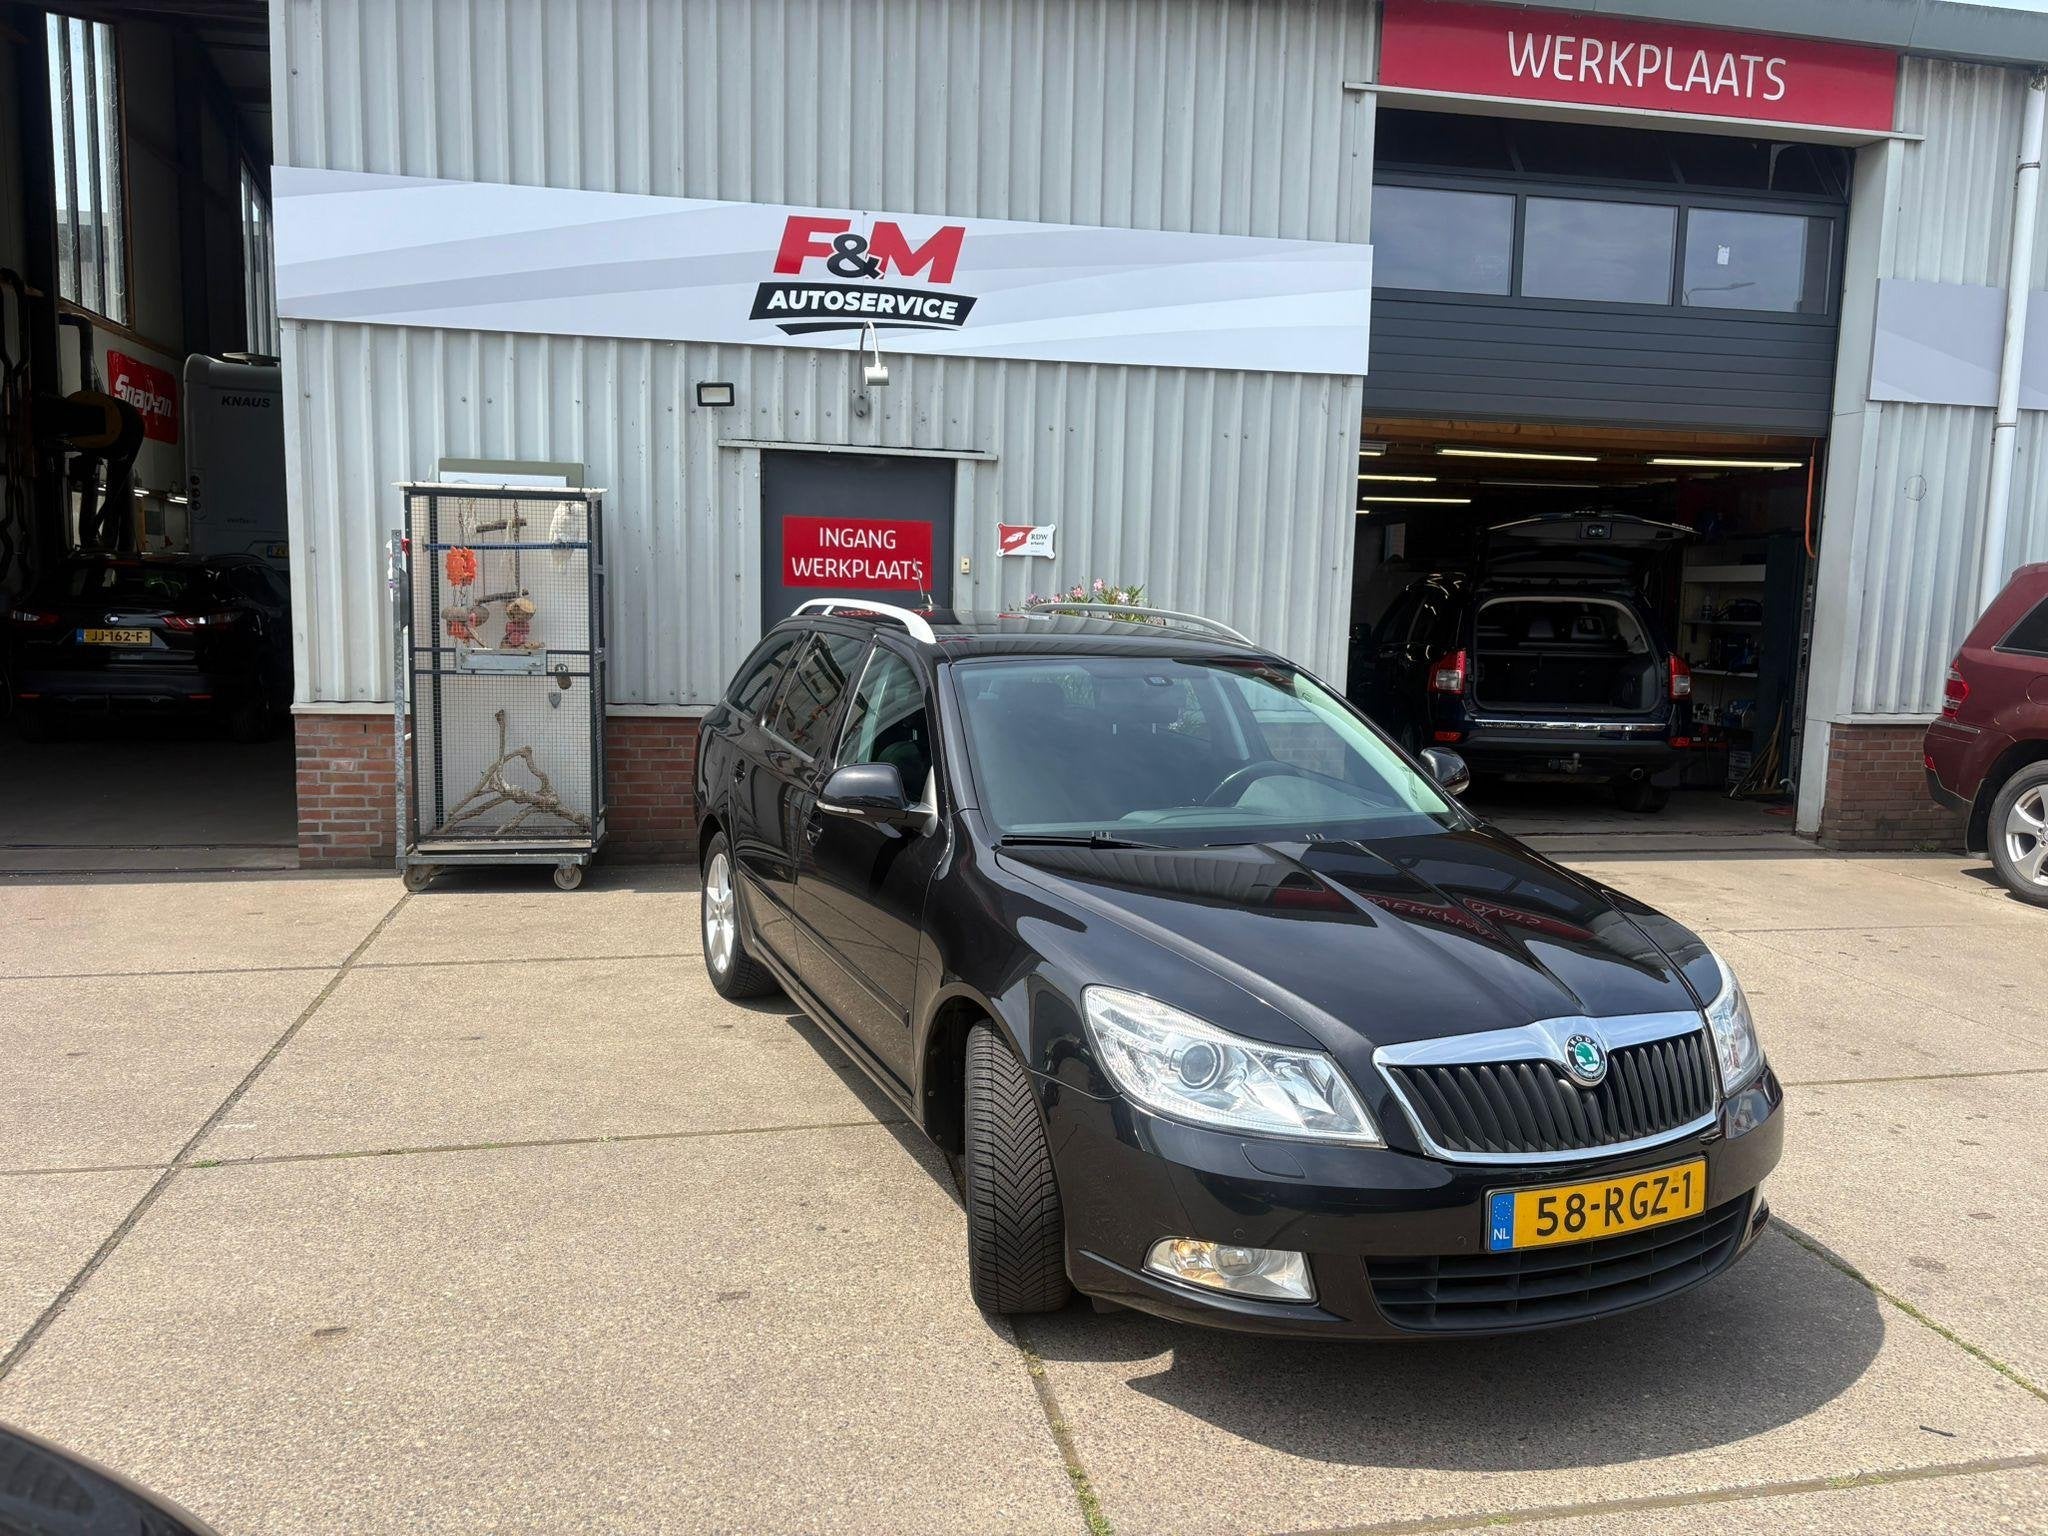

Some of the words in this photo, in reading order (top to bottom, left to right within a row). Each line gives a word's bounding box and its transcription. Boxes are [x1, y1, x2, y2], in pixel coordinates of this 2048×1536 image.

[1507, 30, 1787, 101] WERKPLAATS
[772, 214, 966, 284] F&M
[766, 289, 959, 320] AUTOSERVICE
[113, 373, 172, 416] Snap-on
[221, 395, 271, 408] KNAUS
[819, 526, 896, 550] INGANG
[791, 556, 924, 581] WERKPLAATS
[91, 630, 144, 642] JJ-162-F
[1493, 1228, 1510, 1241] NL
[1536, 1170, 1692, 1237] 58-RGZ-1
